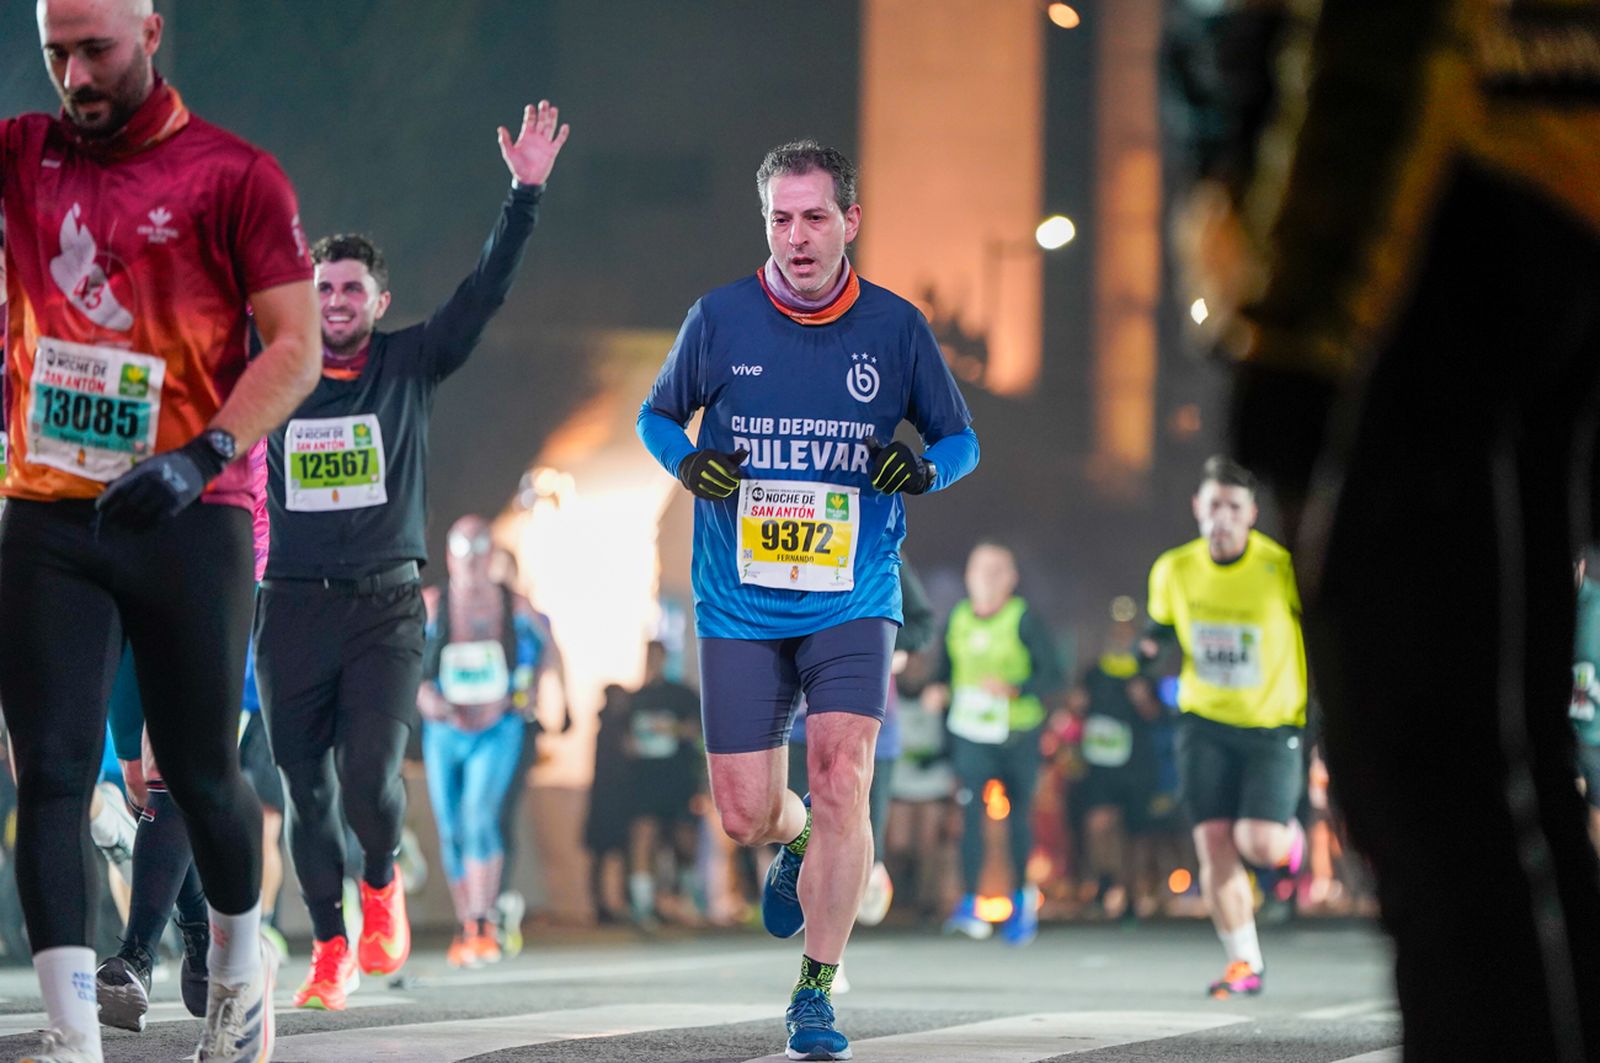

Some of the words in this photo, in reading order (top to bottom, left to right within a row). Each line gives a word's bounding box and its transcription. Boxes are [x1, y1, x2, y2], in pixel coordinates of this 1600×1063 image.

[72, 275, 103, 310] 43
[731, 363, 763, 376] vive
[43, 388, 139, 439] 13085
[731, 415, 774, 435] CLUB
[778, 418, 875, 440] DEPORTIVO
[299, 450, 369, 479] 12567
[765, 493, 800, 504] NOCHE
[801, 495, 815, 505] DE
[751, 505, 774, 517] SAN
[775, 505, 815, 519] ANTÓN
[761, 520, 834, 555] 9372
[777, 554, 815, 563] FERNANDO
